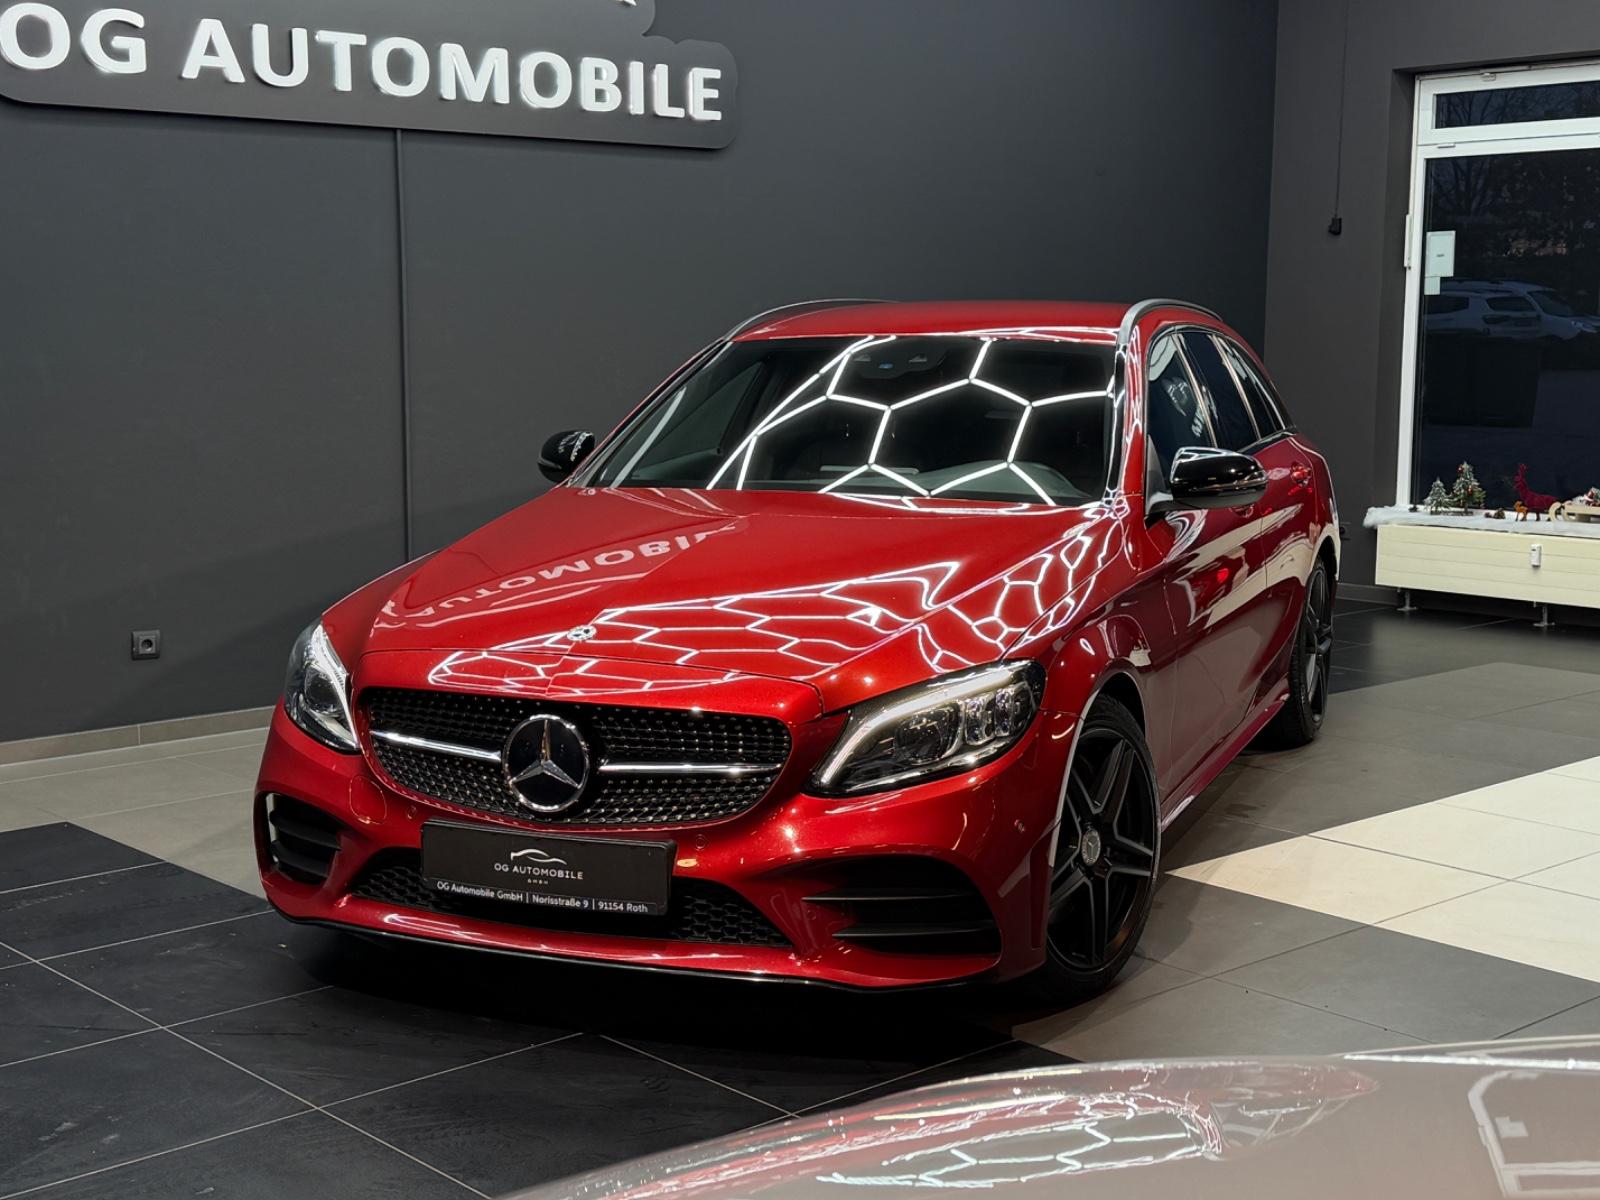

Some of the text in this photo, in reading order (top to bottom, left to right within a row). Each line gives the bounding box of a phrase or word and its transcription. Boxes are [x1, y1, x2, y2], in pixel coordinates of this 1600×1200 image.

[0, 2, 724, 122] OG AUTOMOBILE
[494, 862, 584, 880] OG AUTOMOBILE
[436, 880, 450, 890] OG
[451, 883, 495, 898] Automobile
[497, 890, 523, 902] GmbH
[532, 894, 581, 908] Norisstraße
[583, 900, 589, 908] 9
[598, 901, 624, 911] 91154
[626, 903, 649, 913] Roth
